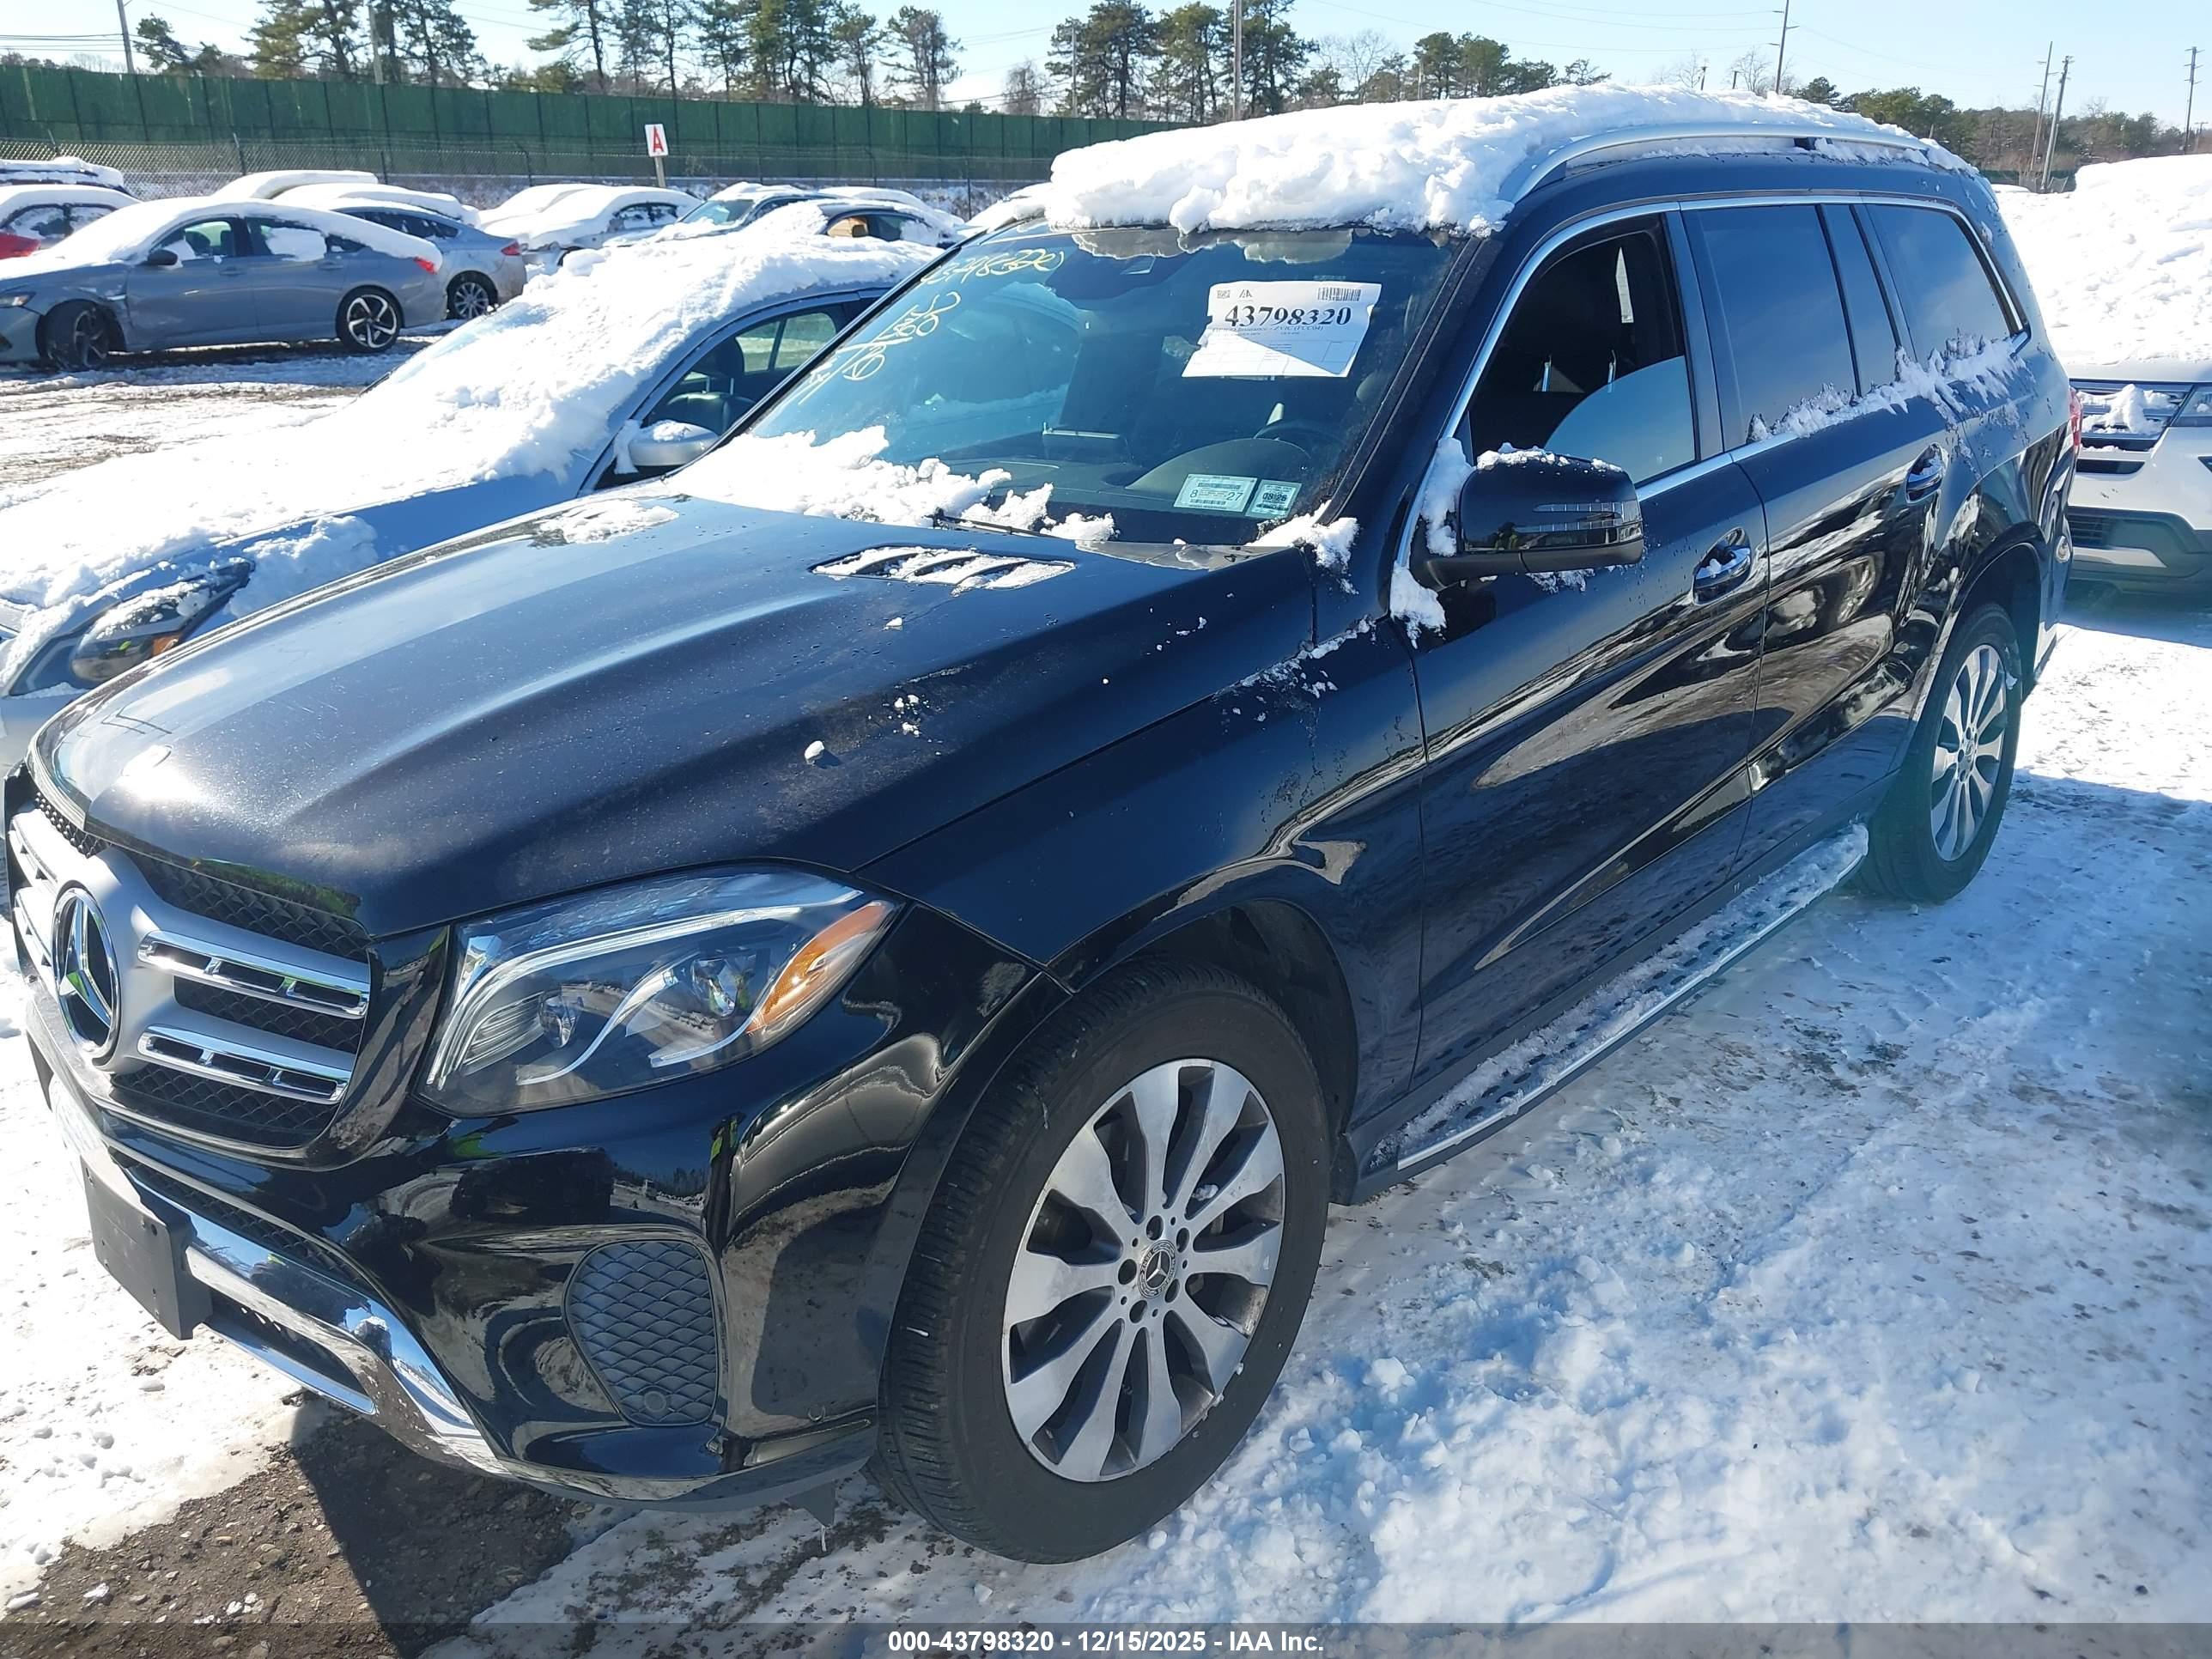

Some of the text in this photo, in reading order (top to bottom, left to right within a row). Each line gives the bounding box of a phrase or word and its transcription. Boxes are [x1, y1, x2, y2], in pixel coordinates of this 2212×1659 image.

[652, 125, 665, 152] A
[1224, 304, 1352, 327] 43798320
[1189, 489, 1199, 498] 8
[1226, 491, 1243, 501] 27
